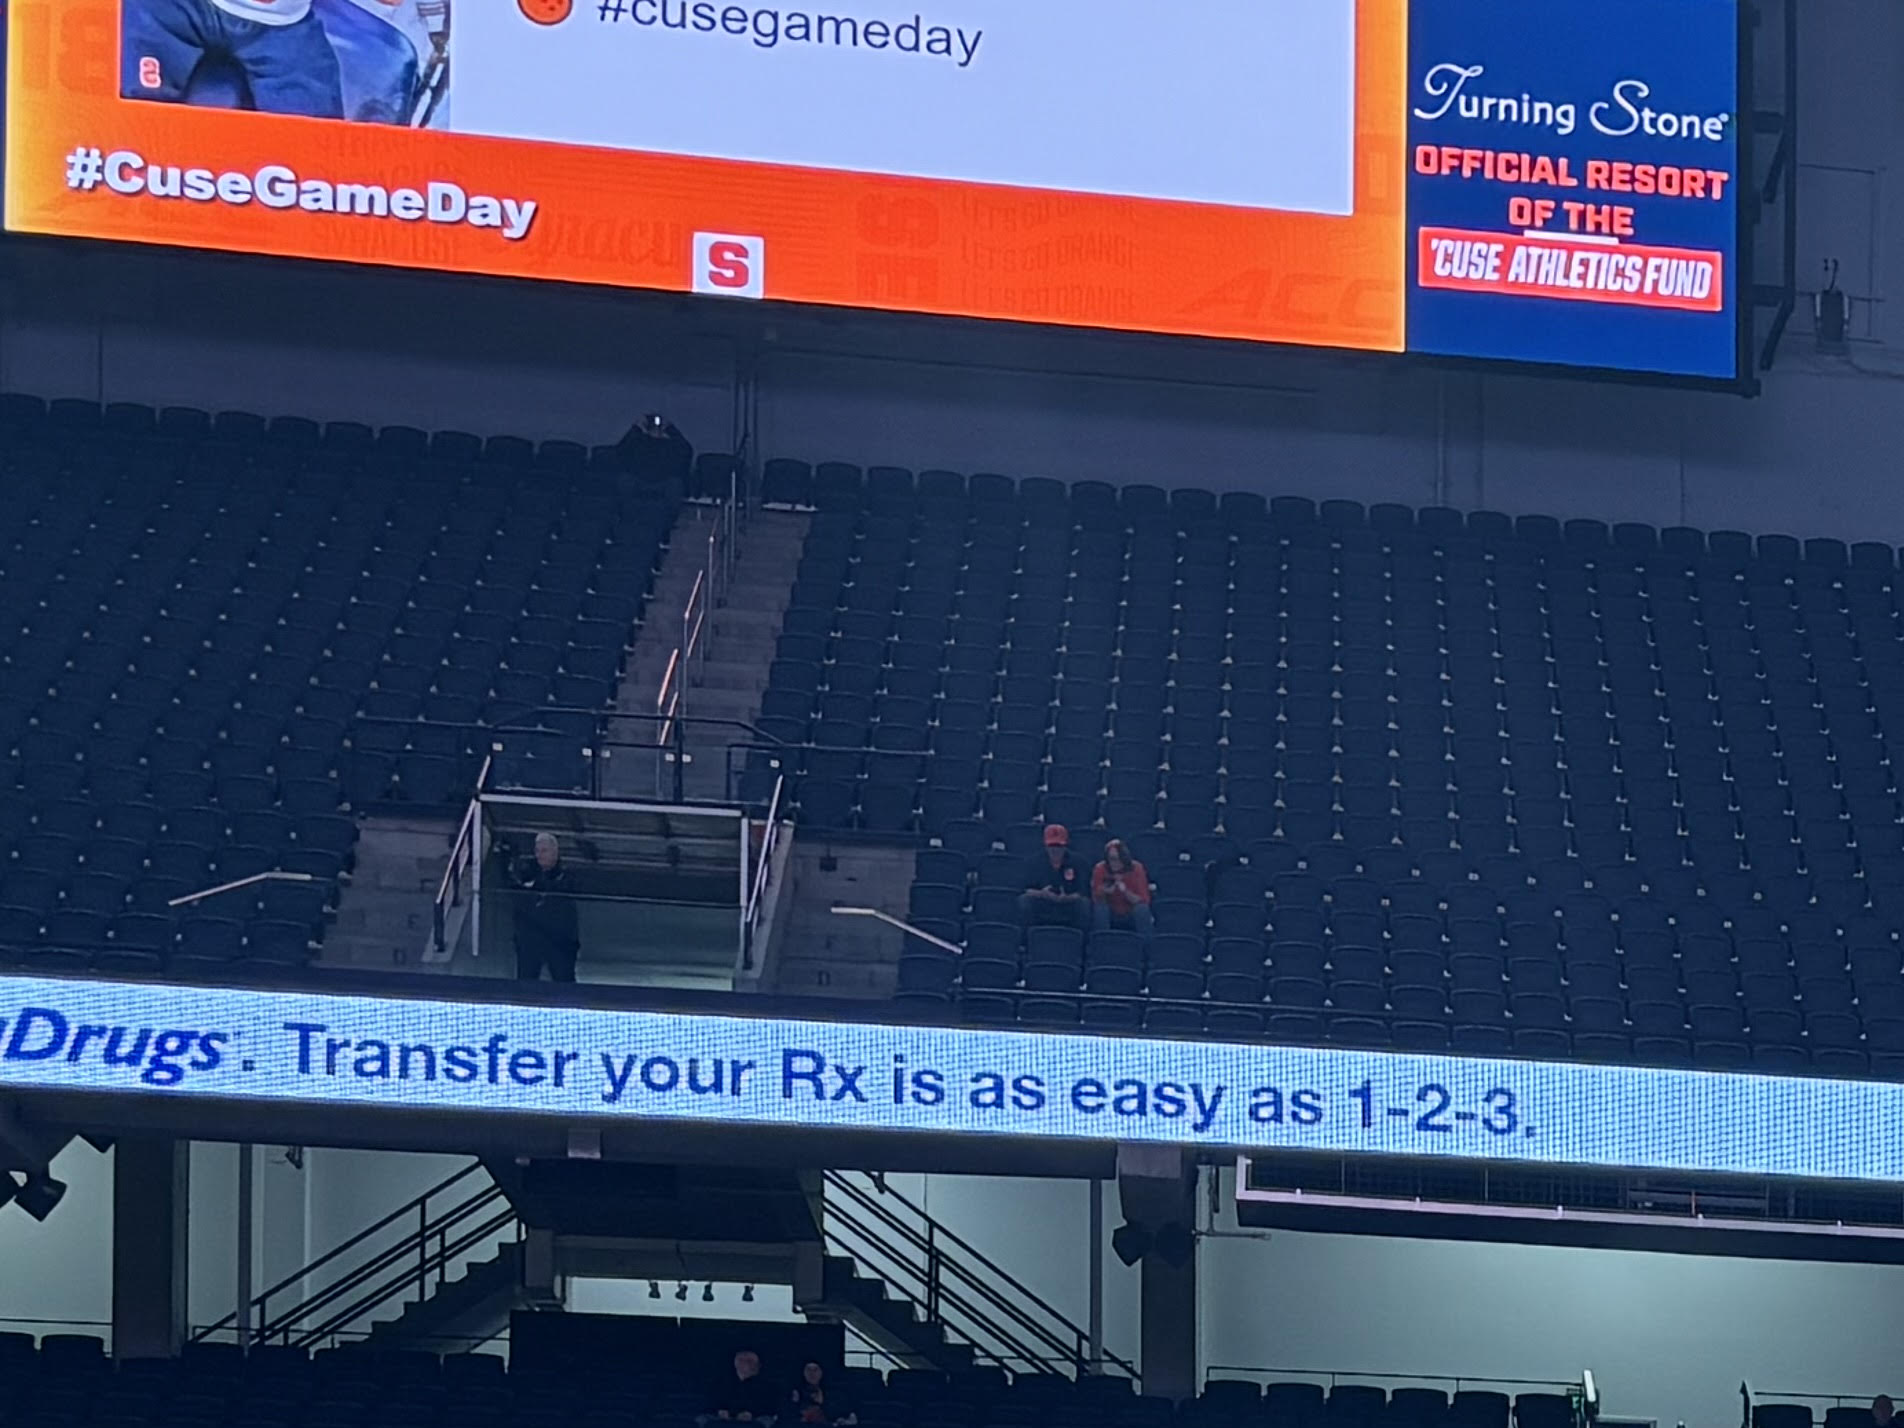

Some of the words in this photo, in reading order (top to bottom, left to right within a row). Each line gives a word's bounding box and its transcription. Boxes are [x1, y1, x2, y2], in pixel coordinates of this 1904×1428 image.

[1413, 63, 1576, 134] Turning
[65, 147, 537, 240] #CuseGameDay
[1414, 145, 1582, 190] OFFICIAL
[1586, 160, 1729, 201] RESORT
[1508, 197, 1555, 230] OF
[1561, 202, 1635, 236] THE
[1507, 245, 1642, 294] ATHLETICS
[1643, 257, 1713, 300] FUND
[0, 1006, 256, 1085] Drugs.
[284, 1021, 578, 1088] Transfer
[600, 1046, 753, 1102] your
[781, 1047, 869, 1104] Rx
[892, 1053, 945, 1108] is
[969, 1070, 1046, 1111] as
[1070, 1077, 1222, 1133] easy
[1248, 1089, 1324, 1127] as
[1349, 1079, 1537, 1137] 1-2-3.
